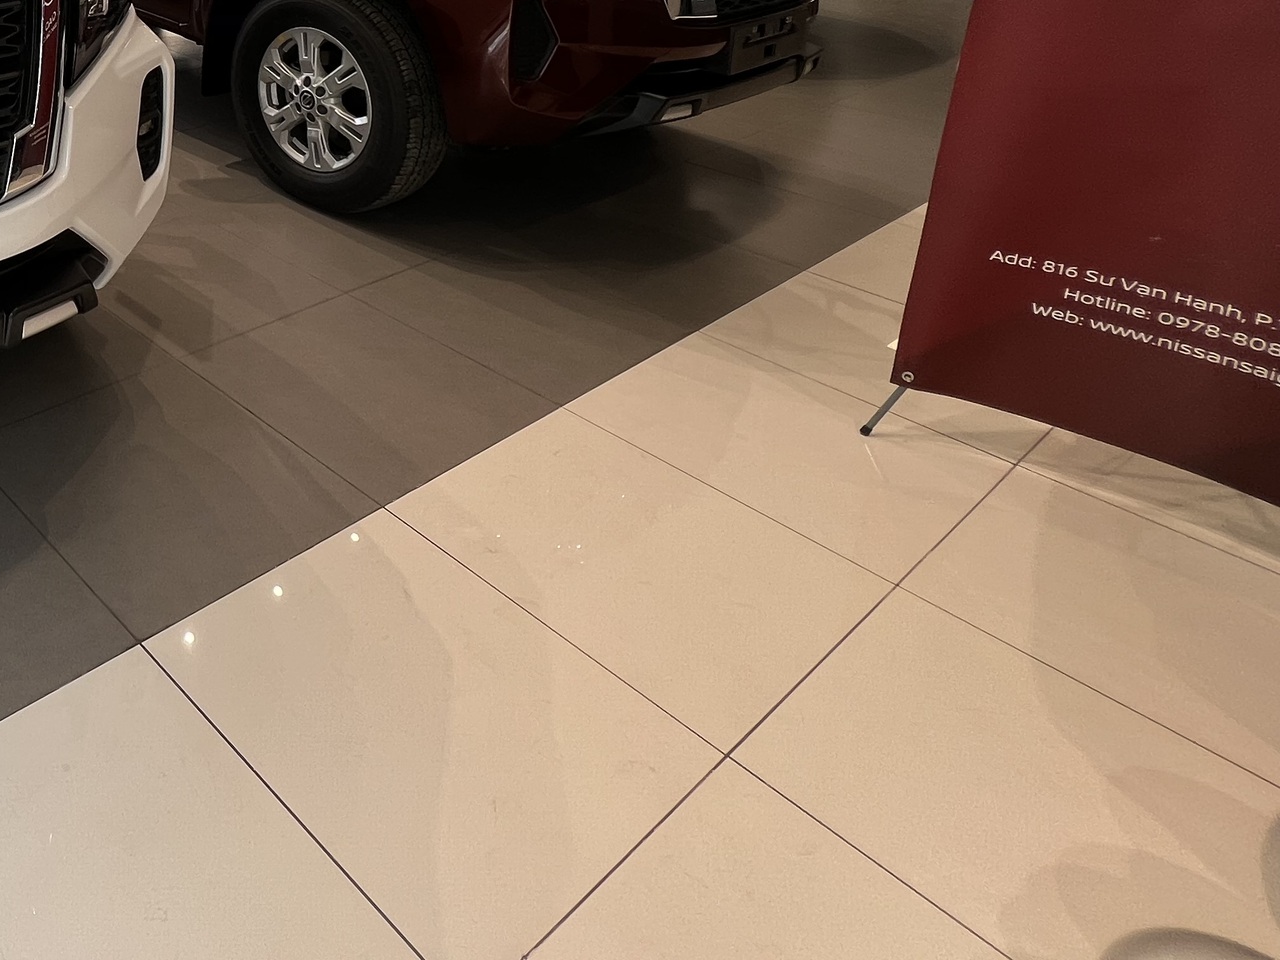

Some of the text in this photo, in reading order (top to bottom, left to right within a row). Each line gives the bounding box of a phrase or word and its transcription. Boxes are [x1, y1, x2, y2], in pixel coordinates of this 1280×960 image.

[989, 250, 1280, 330] Add: 816 Sư Vạn Hạnh, P.
[1063, 287, 1151, 320] Hotline:
